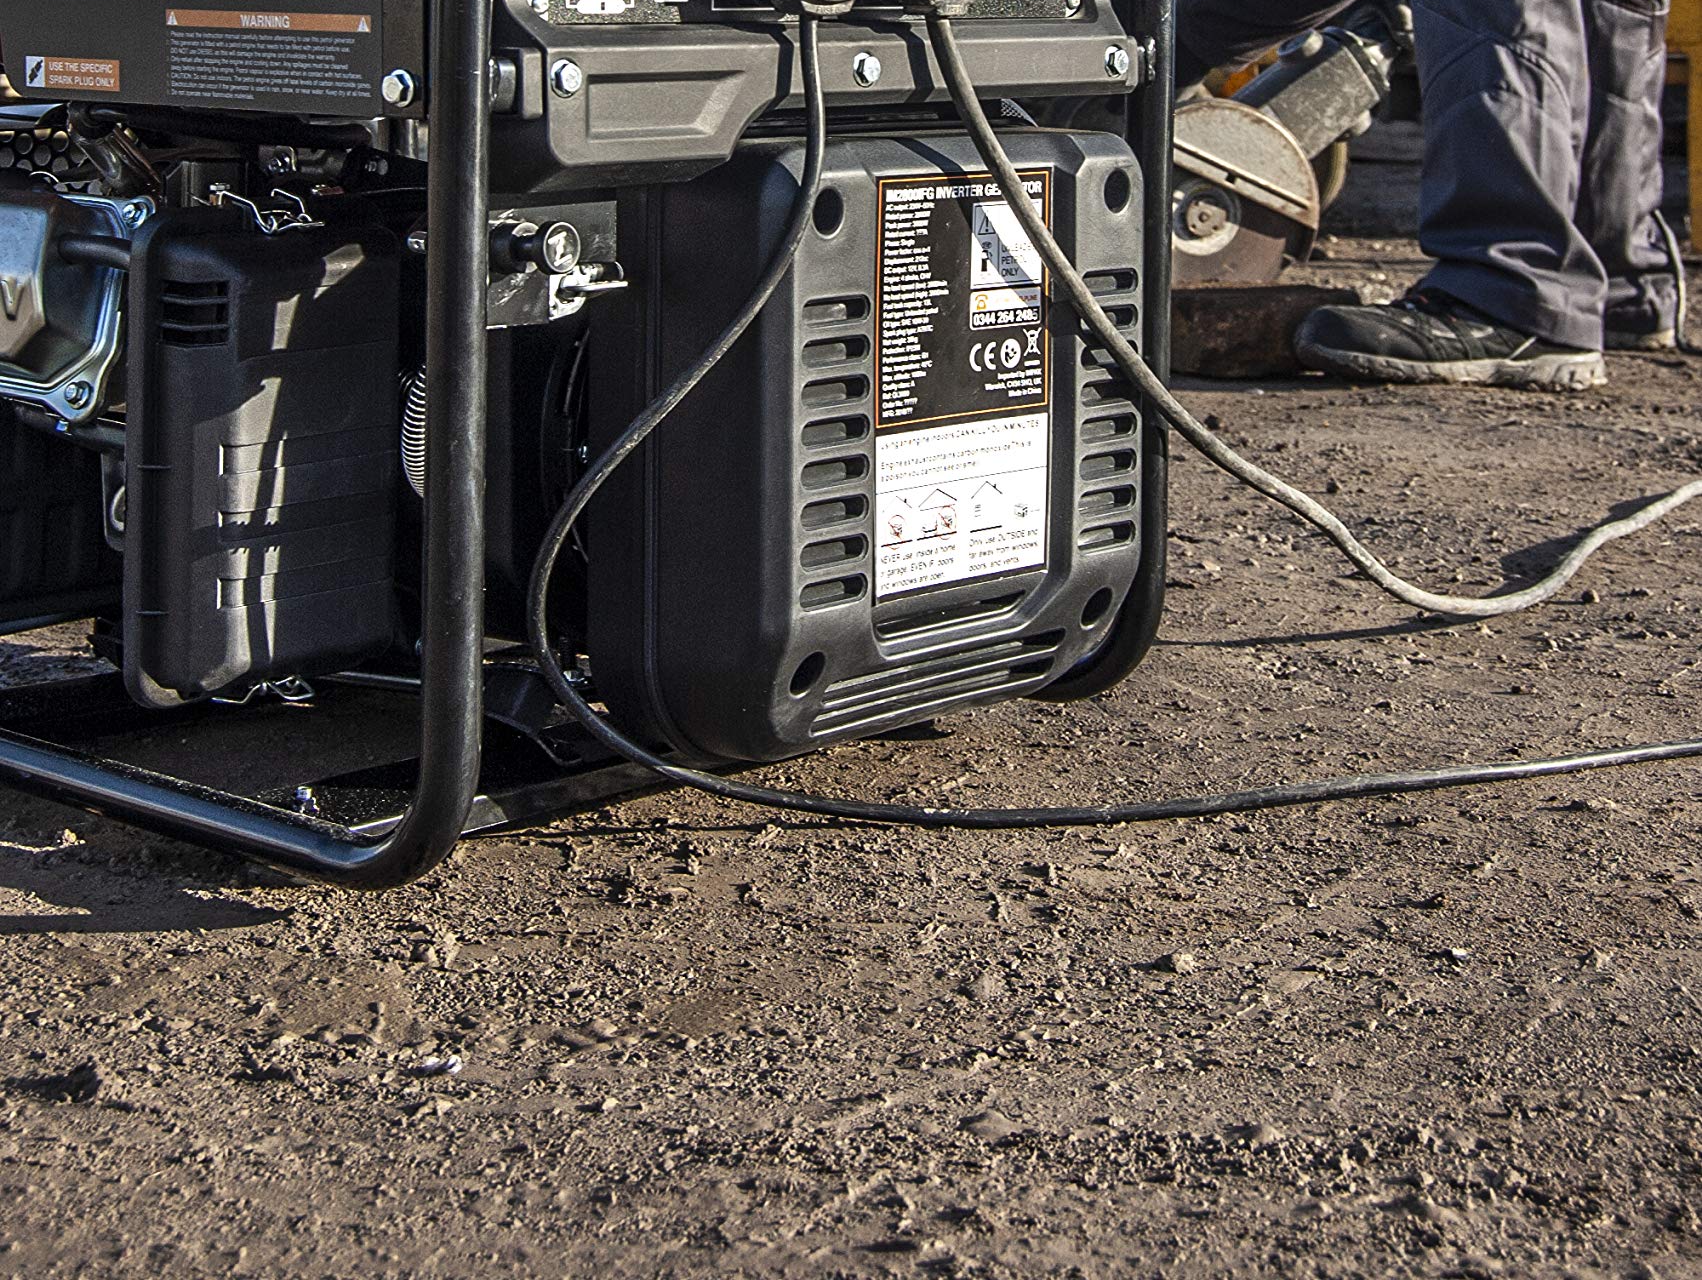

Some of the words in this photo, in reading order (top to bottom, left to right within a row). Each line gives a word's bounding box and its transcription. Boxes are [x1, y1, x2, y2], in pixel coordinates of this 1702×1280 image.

[240, 15, 290, 28] WARNING
[49, 62, 63, 71] USE
[64, 63, 79, 72] THE
[80, 63, 113, 74] SPECIFIC
[49, 75, 73, 84] SPARK
[74, 77, 94, 86] PLUG
[96, 77, 115, 87] ONLY
[936, 184, 983, 198] INVERTER
[1002, 268, 1019, 277] ONLY
[973, 313, 996, 326] 0344
[997, 311, 1015, 324] 264
[970, 342, 997, 372] CE
